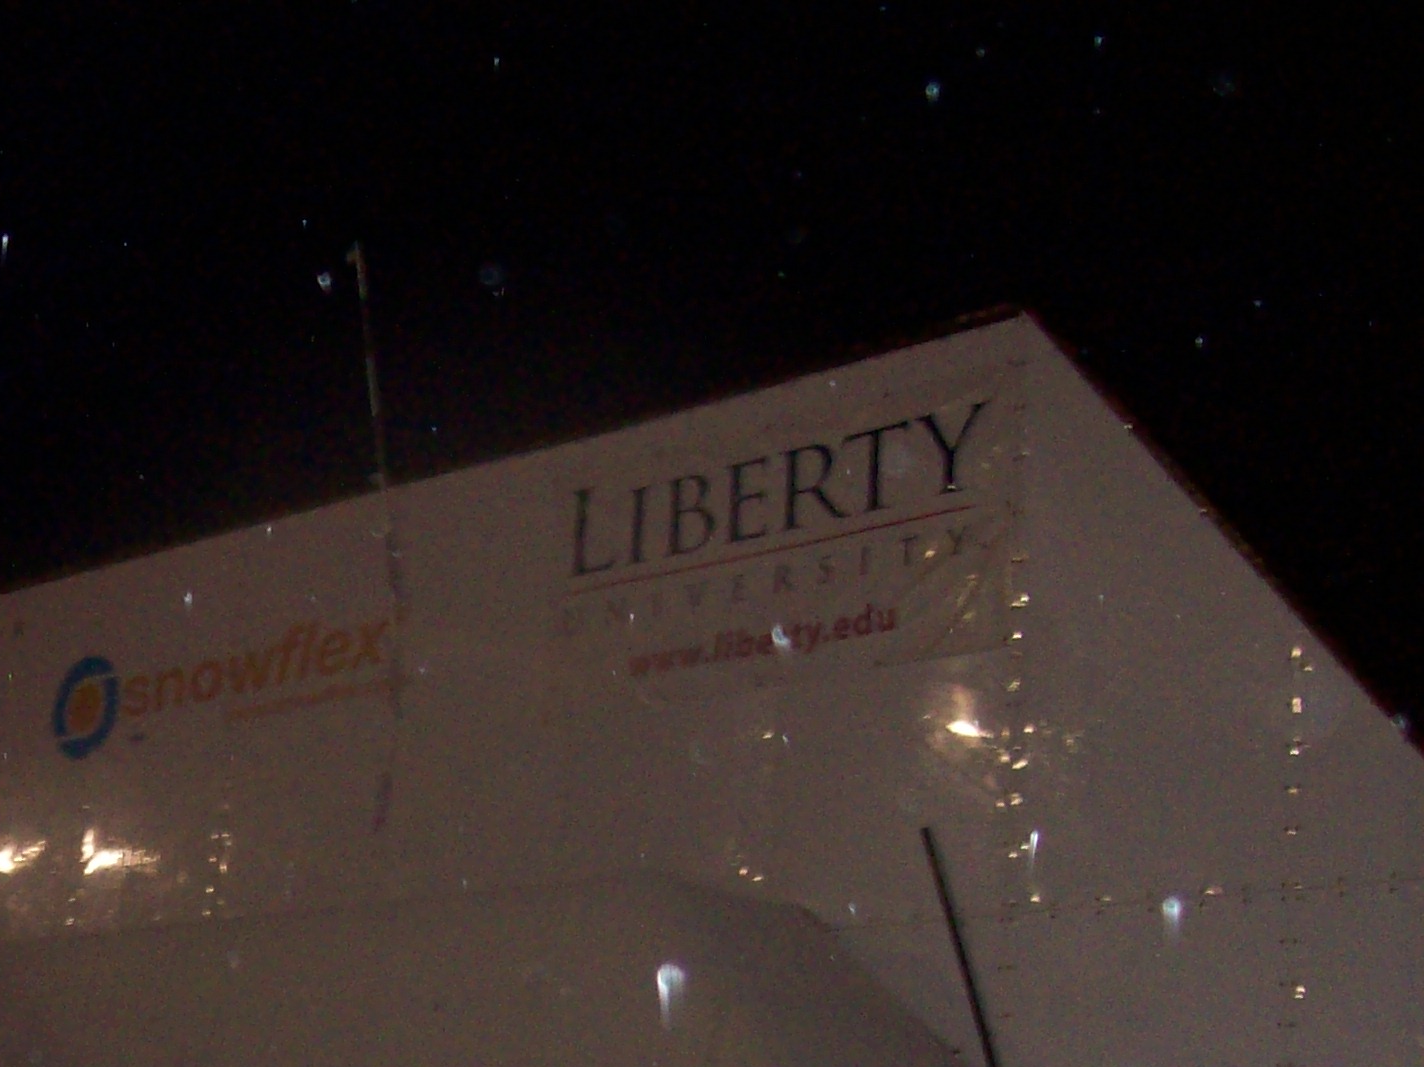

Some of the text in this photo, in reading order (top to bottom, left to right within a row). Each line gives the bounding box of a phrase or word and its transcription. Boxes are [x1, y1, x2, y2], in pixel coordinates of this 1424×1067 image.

[570, 399, 993, 577] LIBERTY
[120, 617, 391, 717] snowflex
[627, 602, 899, 678] www.libety.edu
